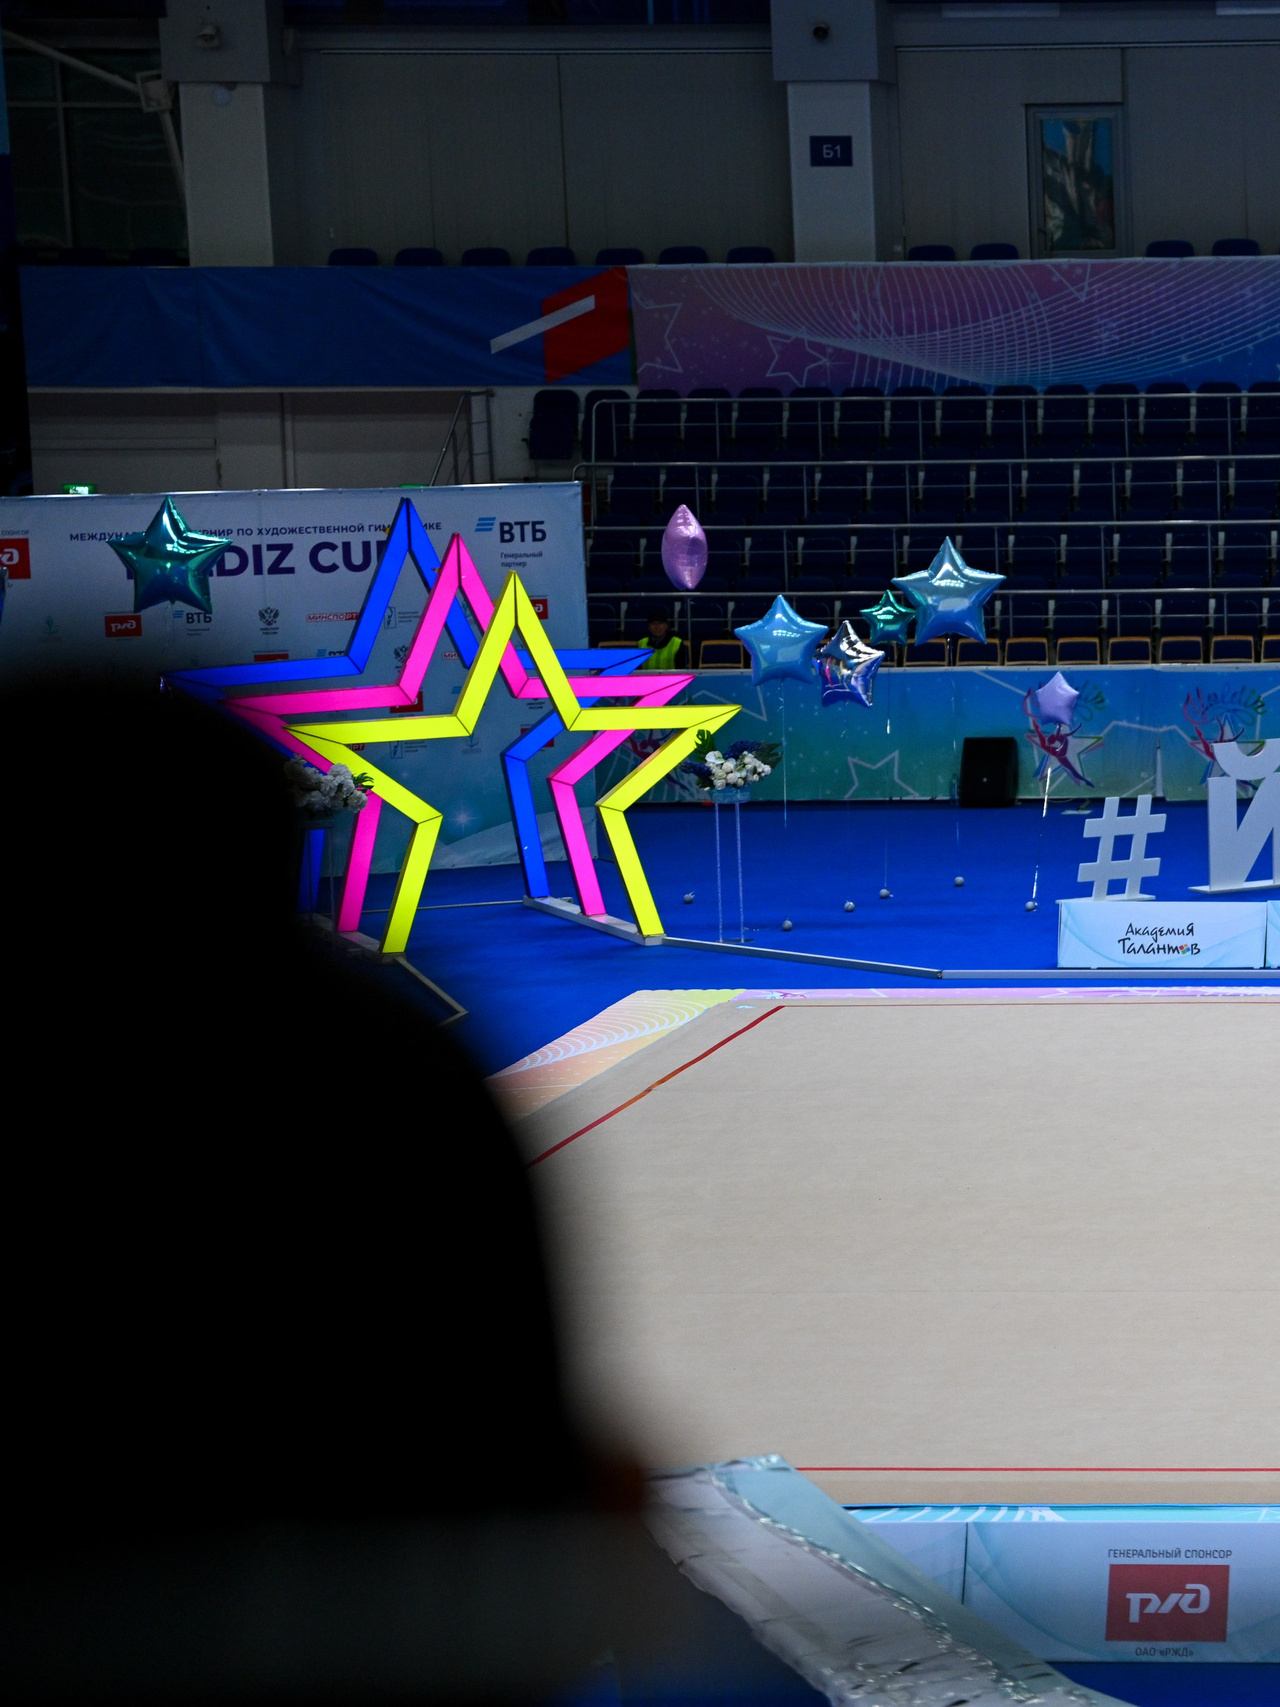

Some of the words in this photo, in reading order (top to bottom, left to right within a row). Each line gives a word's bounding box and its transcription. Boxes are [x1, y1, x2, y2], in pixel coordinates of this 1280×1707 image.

[822, 143, 841, 159] Б1
[236, 527, 254, 537] ПО
[257, 522, 365, 537] ХУДОЖЕСТВЕННОЙ
[499, 520, 547, 544] ВТБ
[186, 611, 213, 624] ВТБ
[1125, 922, 1195, 944] Академия
[1107, 1547, 1182, 1559] ГЕНЕРАЛЬНЫЙ
[1184, 1548, 1233, 1559] СПОНСОР
[1134, 1646, 1157, 1657] ОАО
[1159, 1647, 1195, 1658] «РЖД»
